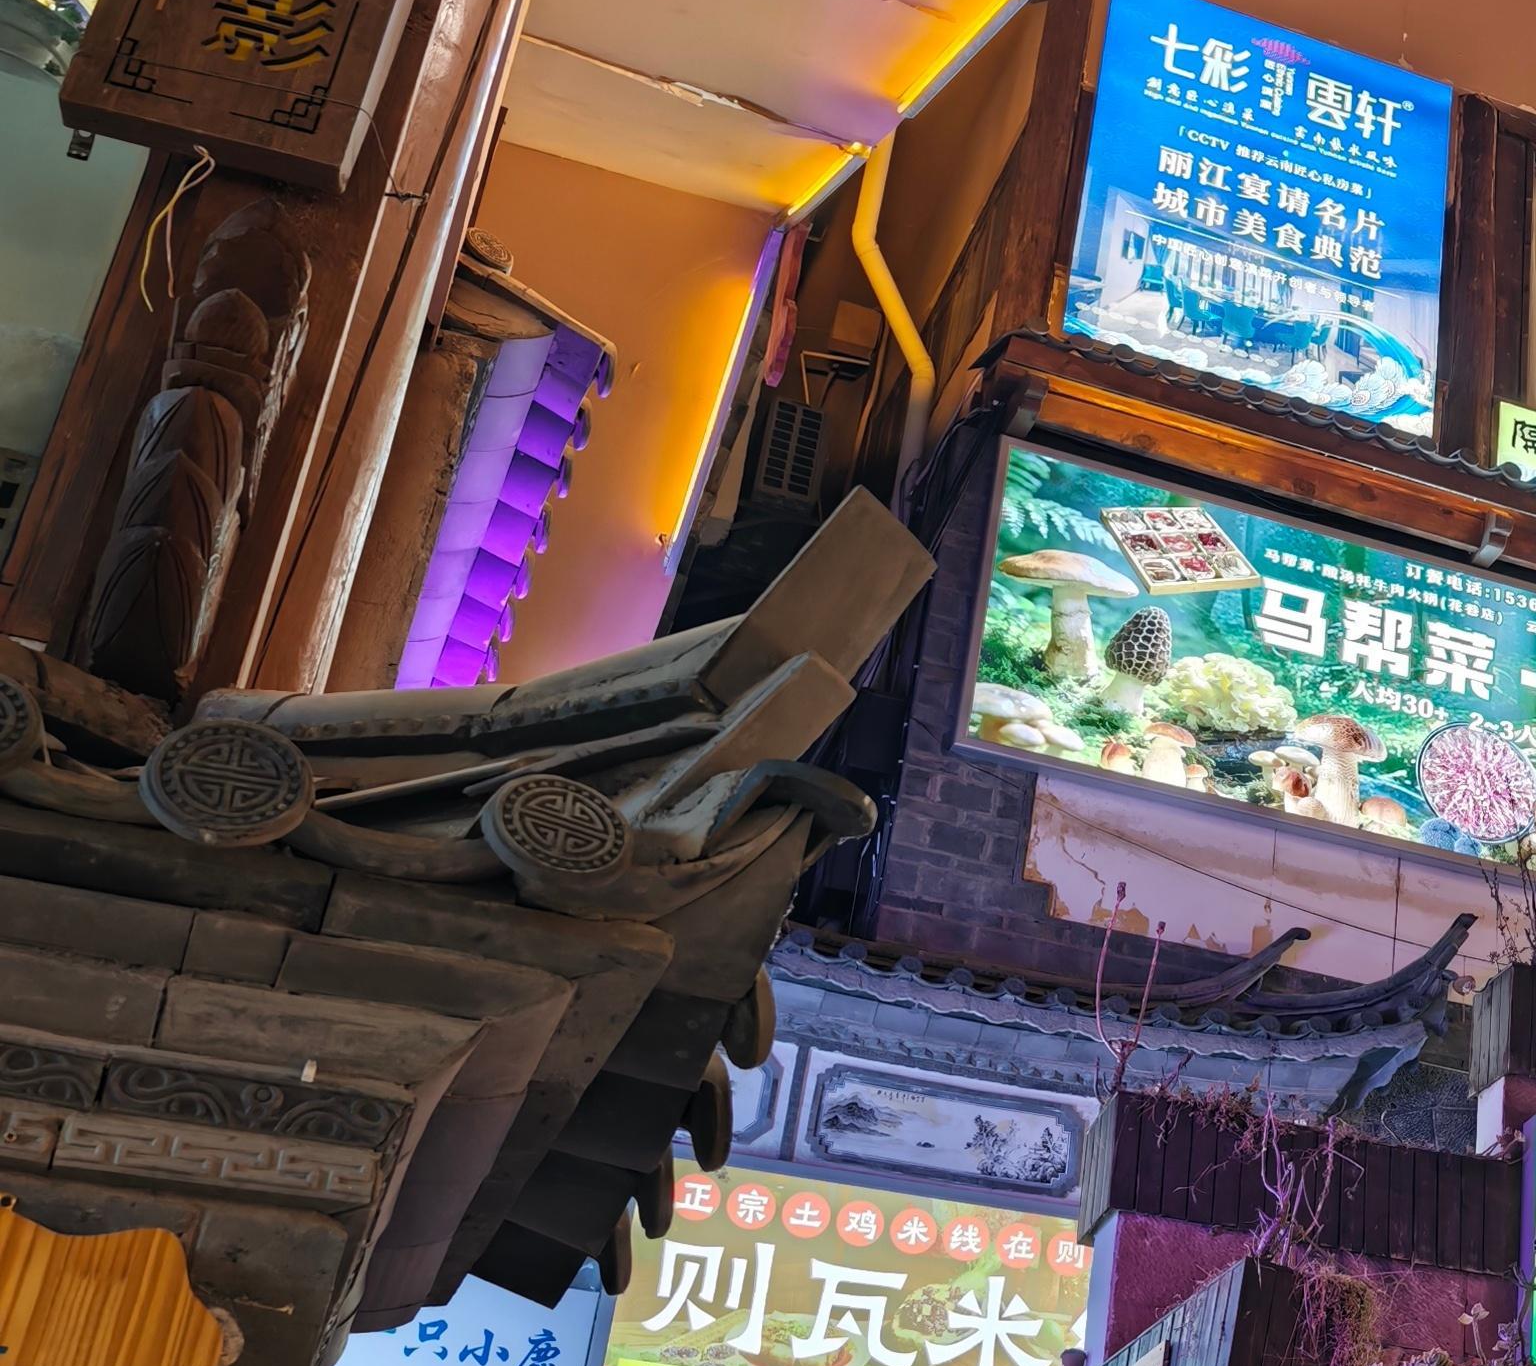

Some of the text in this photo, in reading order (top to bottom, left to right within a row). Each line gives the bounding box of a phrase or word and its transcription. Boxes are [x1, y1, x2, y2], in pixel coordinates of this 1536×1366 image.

[1150, 23, 1251, 93] 七彩
[1152, 182, 1383, 280] 城市美食典范
[1157, 145, 1386, 241] 丽江宴请名片
[1349, 680, 1449, 723] 人均30+
[678, 1180, 1087, 1268] 正宗土鸡米线在则
